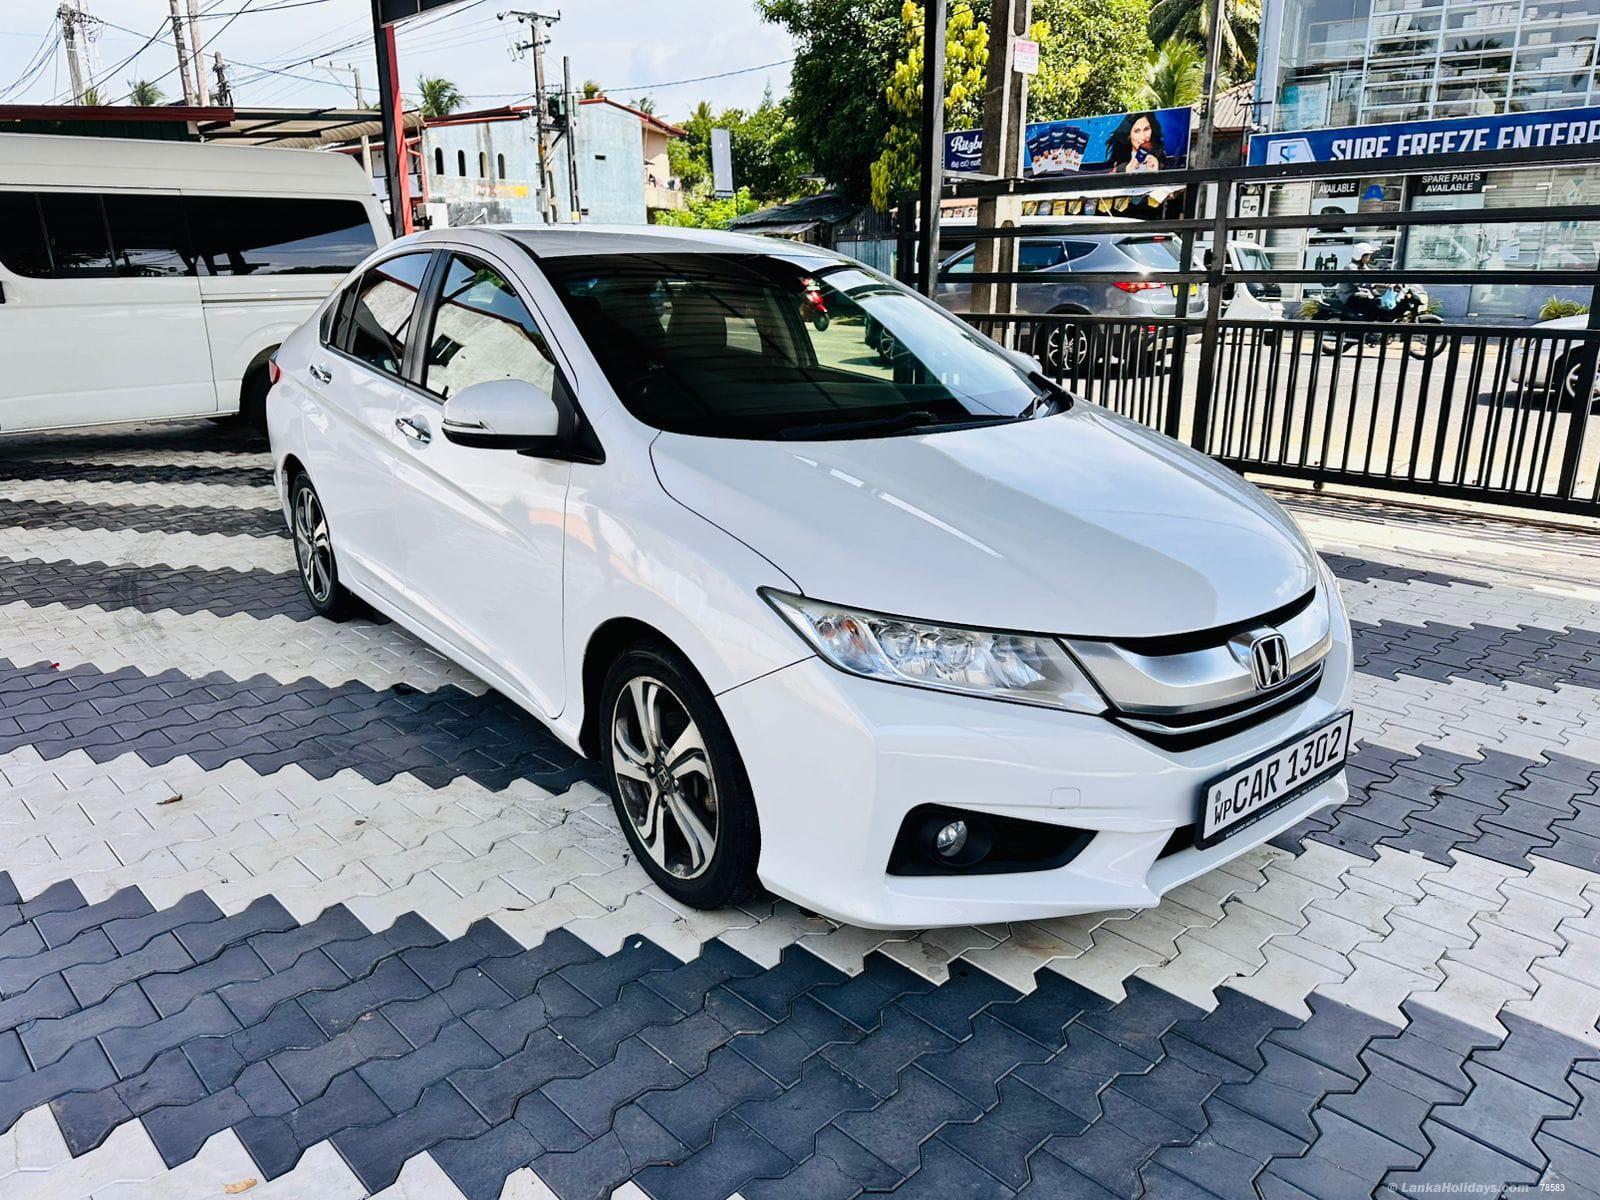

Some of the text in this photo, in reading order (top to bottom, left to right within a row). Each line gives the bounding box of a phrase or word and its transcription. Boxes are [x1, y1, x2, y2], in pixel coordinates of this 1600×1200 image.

[1421, 172, 1481, 184] SPARE PARTS
[1318, 182, 1356, 194] AVAILABLE
[1425, 182, 1474, 193] AVAILABLE
[1214, 798, 1232, 825] WP
[1232, 758, 1280, 814] CAR
[1285, 726, 1342, 786] 1302
